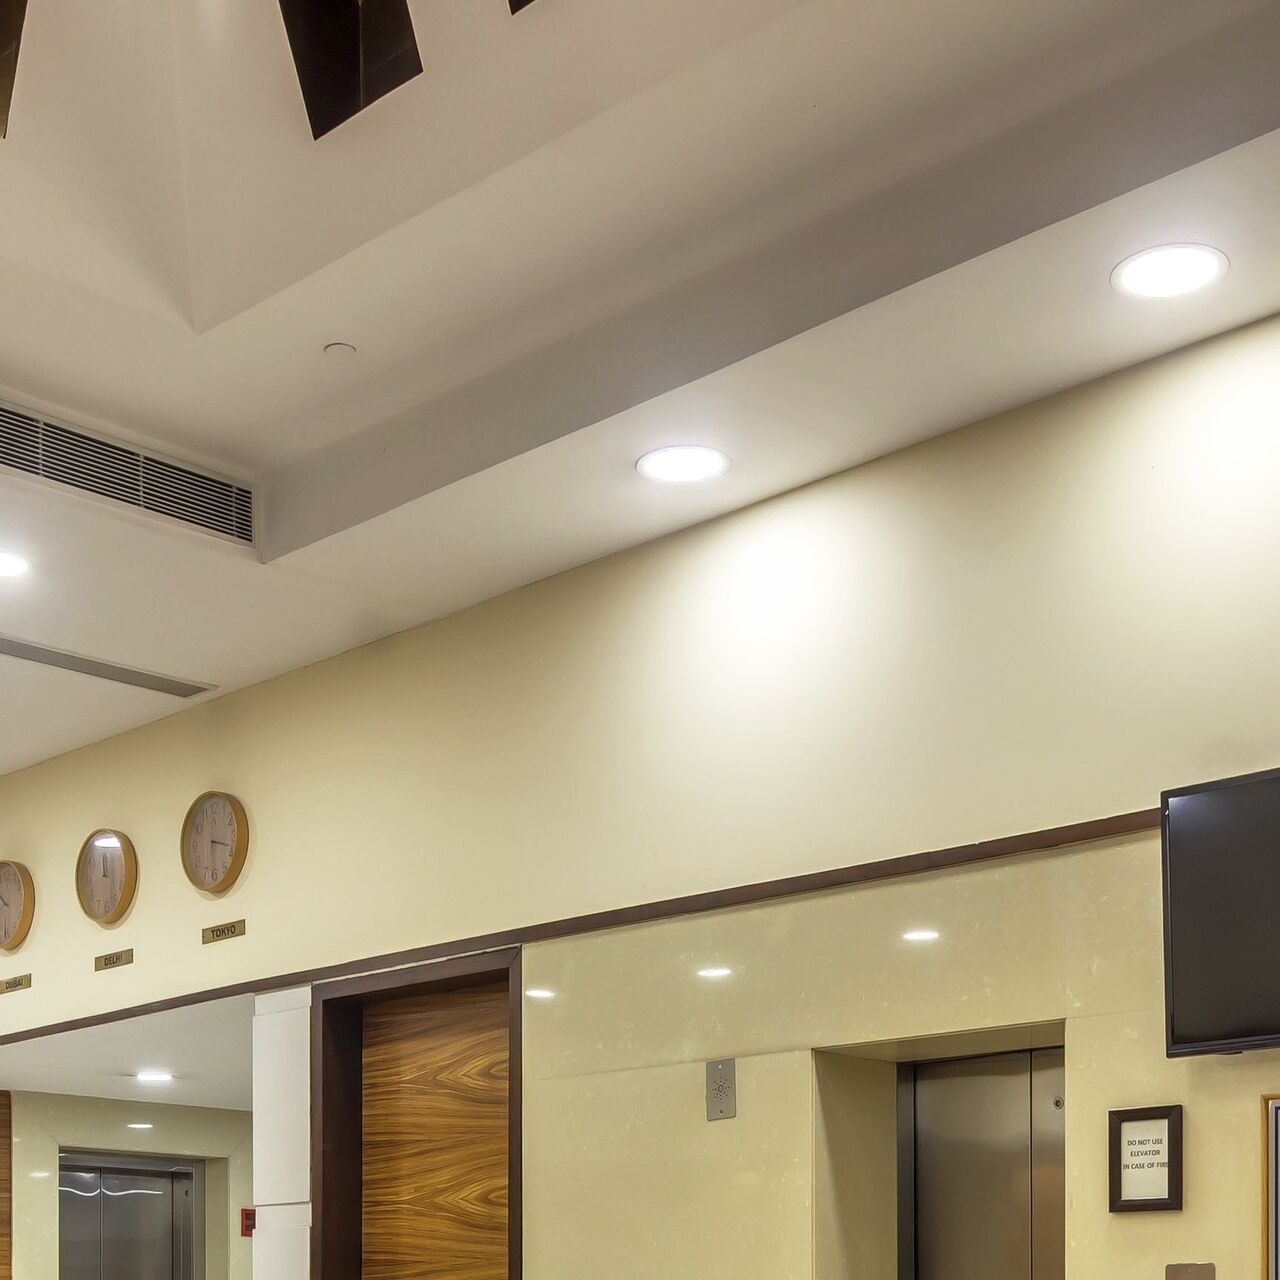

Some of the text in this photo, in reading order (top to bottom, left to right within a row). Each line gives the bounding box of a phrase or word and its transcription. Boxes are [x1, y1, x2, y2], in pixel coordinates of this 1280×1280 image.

[210, 924, 236, 939] TOKYO
[1127, 1139, 1137, 1147] DO
[1152, 1138, 1163, 1146] USE
[1130, 1149, 1161, 1158] ELEVATOR
